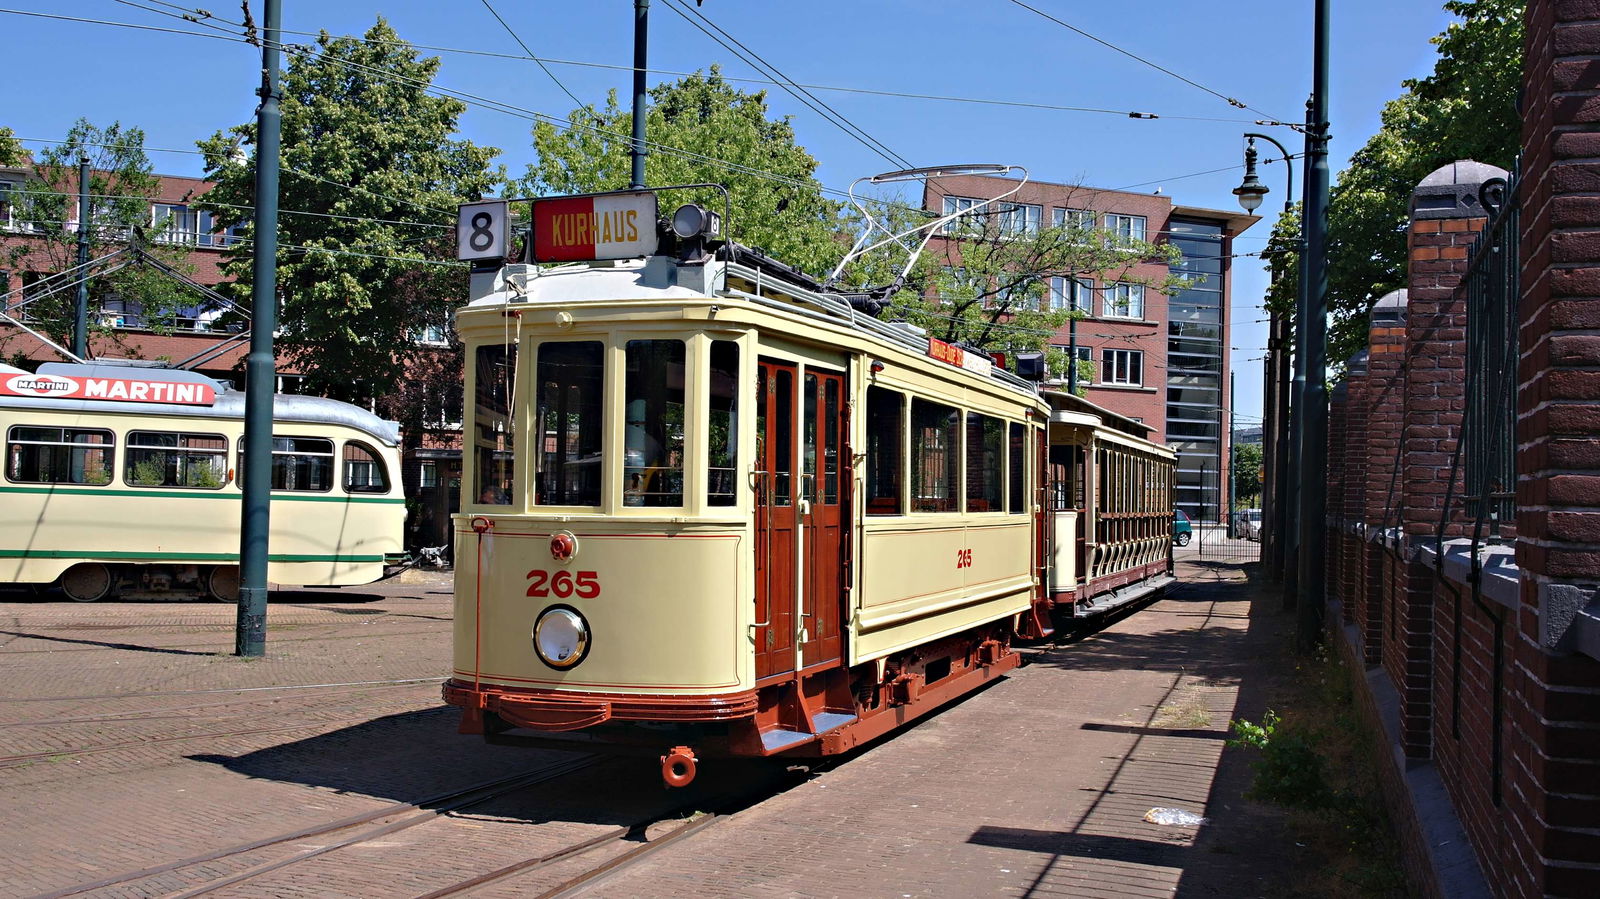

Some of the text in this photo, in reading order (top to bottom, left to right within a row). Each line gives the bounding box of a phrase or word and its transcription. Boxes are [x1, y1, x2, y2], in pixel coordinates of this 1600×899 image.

[469, 212, 495, 251] 8
[552, 210, 638, 247] KURHAUS
[17, 380, 69, 391] MARTINI
[84, 379, 204, 403] MARTINI
[957, 548, 972, 569] 265
[526, 569, 601, 599] 265
